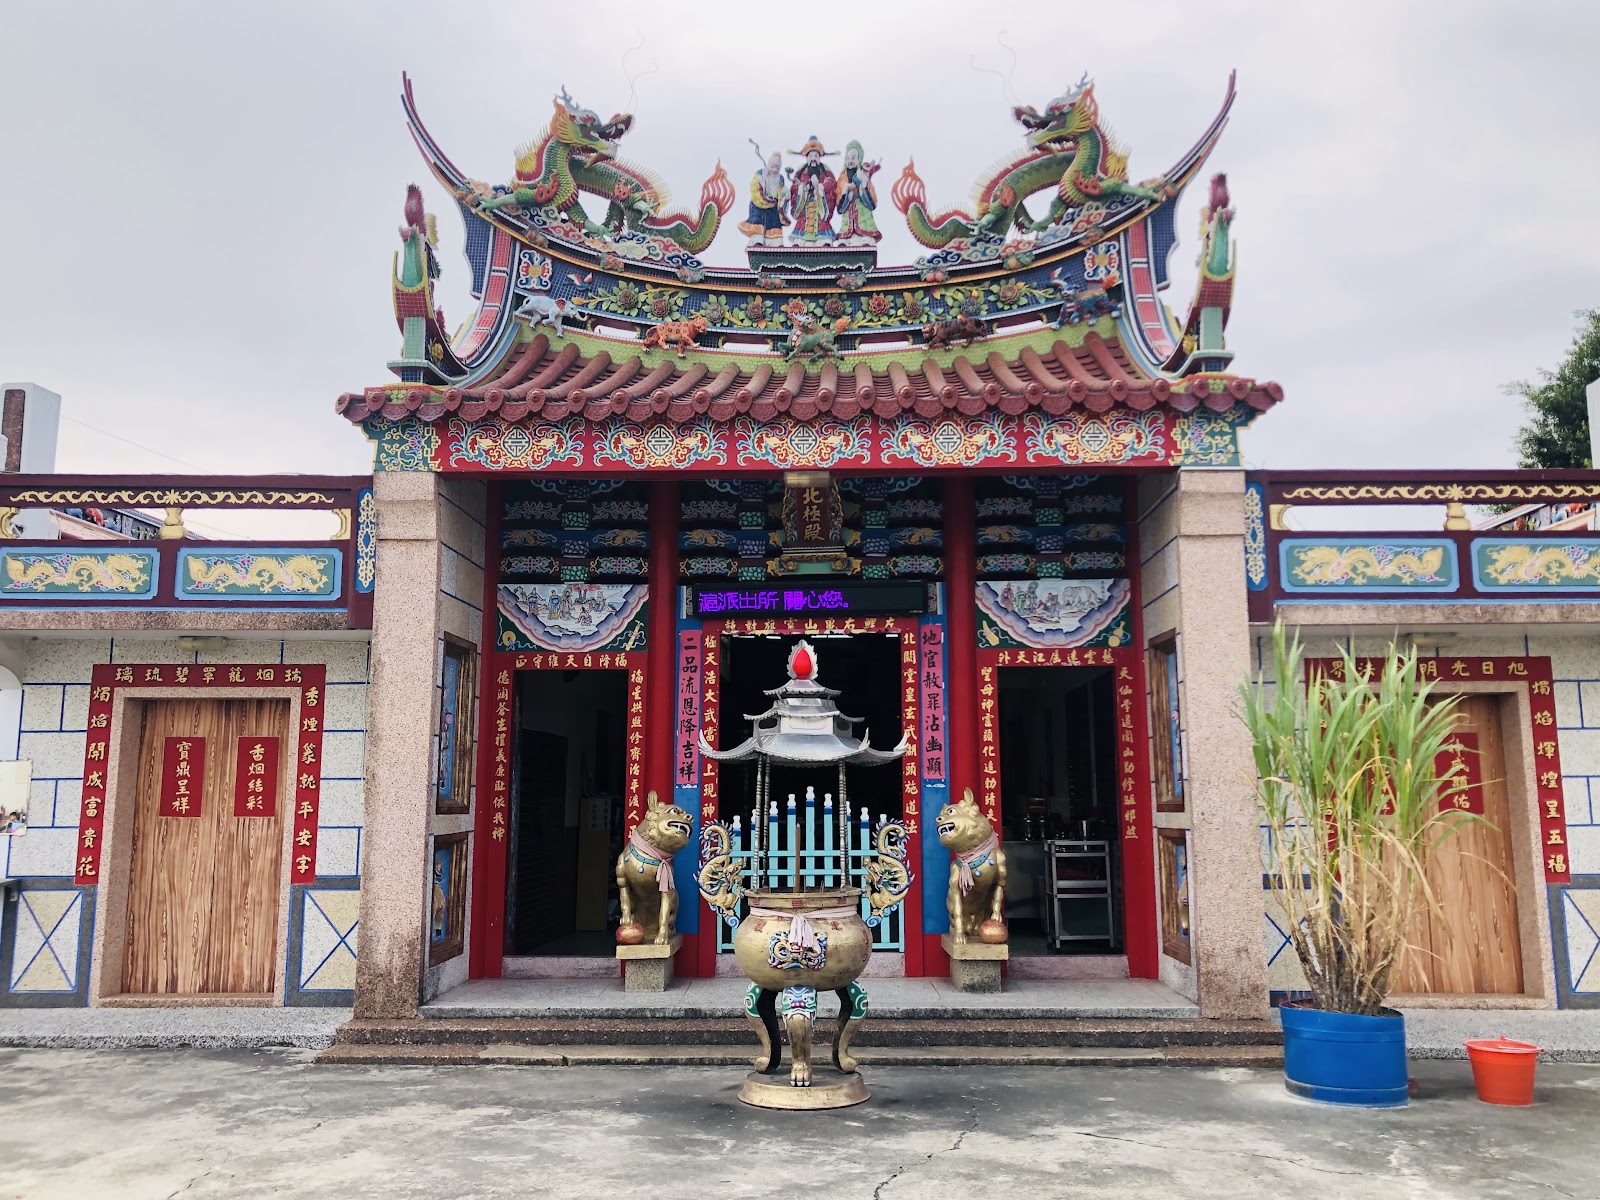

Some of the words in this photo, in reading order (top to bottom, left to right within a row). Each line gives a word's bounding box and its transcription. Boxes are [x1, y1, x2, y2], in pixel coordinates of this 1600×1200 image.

[803, 487, 825, 541] 北極殿
[679, 636, 699, 782] 二品流恩降吉祥
[702, 635, 718, 819] 極天浩大武當上現神
[172, 741, 190, 814] 寶鼎呈祥
[246, 743, 265, 810] 香烟結彩
